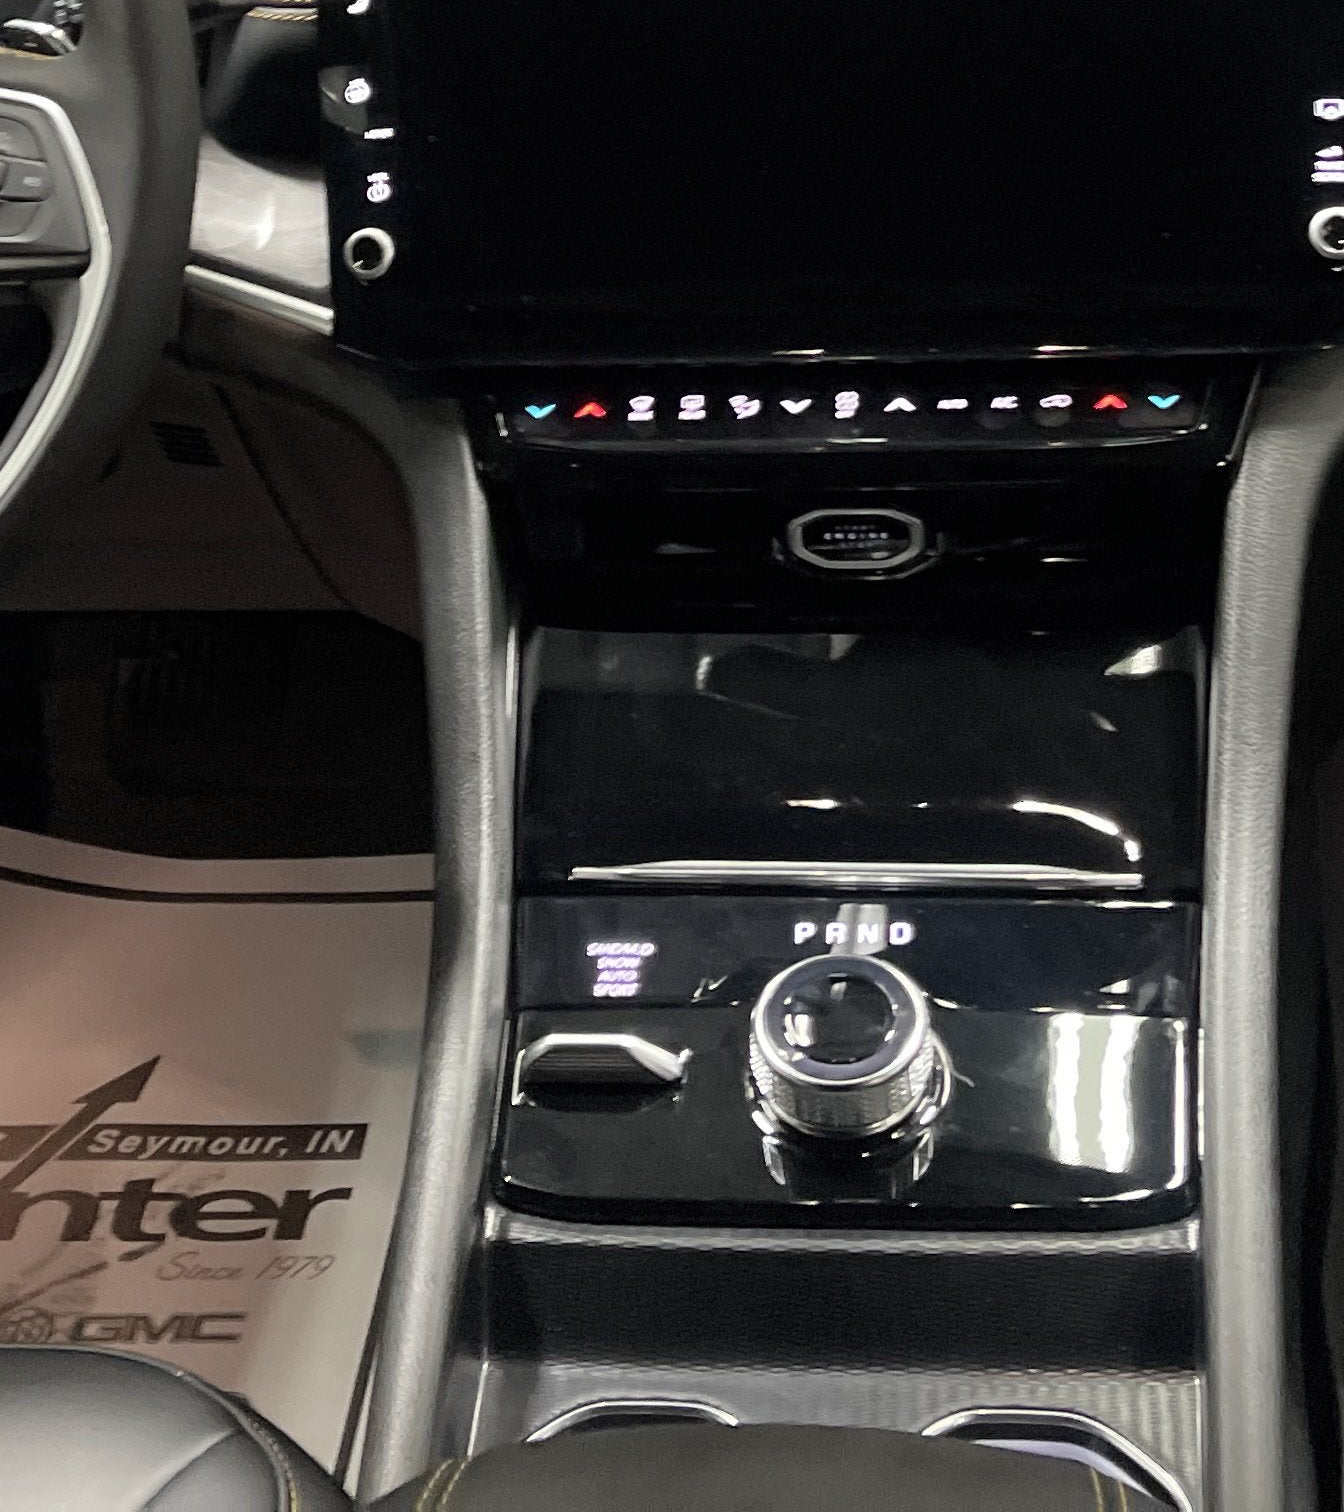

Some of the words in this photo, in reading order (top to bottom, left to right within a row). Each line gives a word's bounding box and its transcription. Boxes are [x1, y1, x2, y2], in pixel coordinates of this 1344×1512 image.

[794, 922, 817, 944] P
[825, 922, 847, 944] R
[857, 922, 879, 944] N
[889, 921, 915, 945] D
[85, 1128, 289, 1161] Seymour,
[302, 1128, 355, 1154] IN
[155, 1251, 245, 1282] Since
[255, 1254, 338, 1281] 1979
[69, 1312, 251, 1343] GMC
